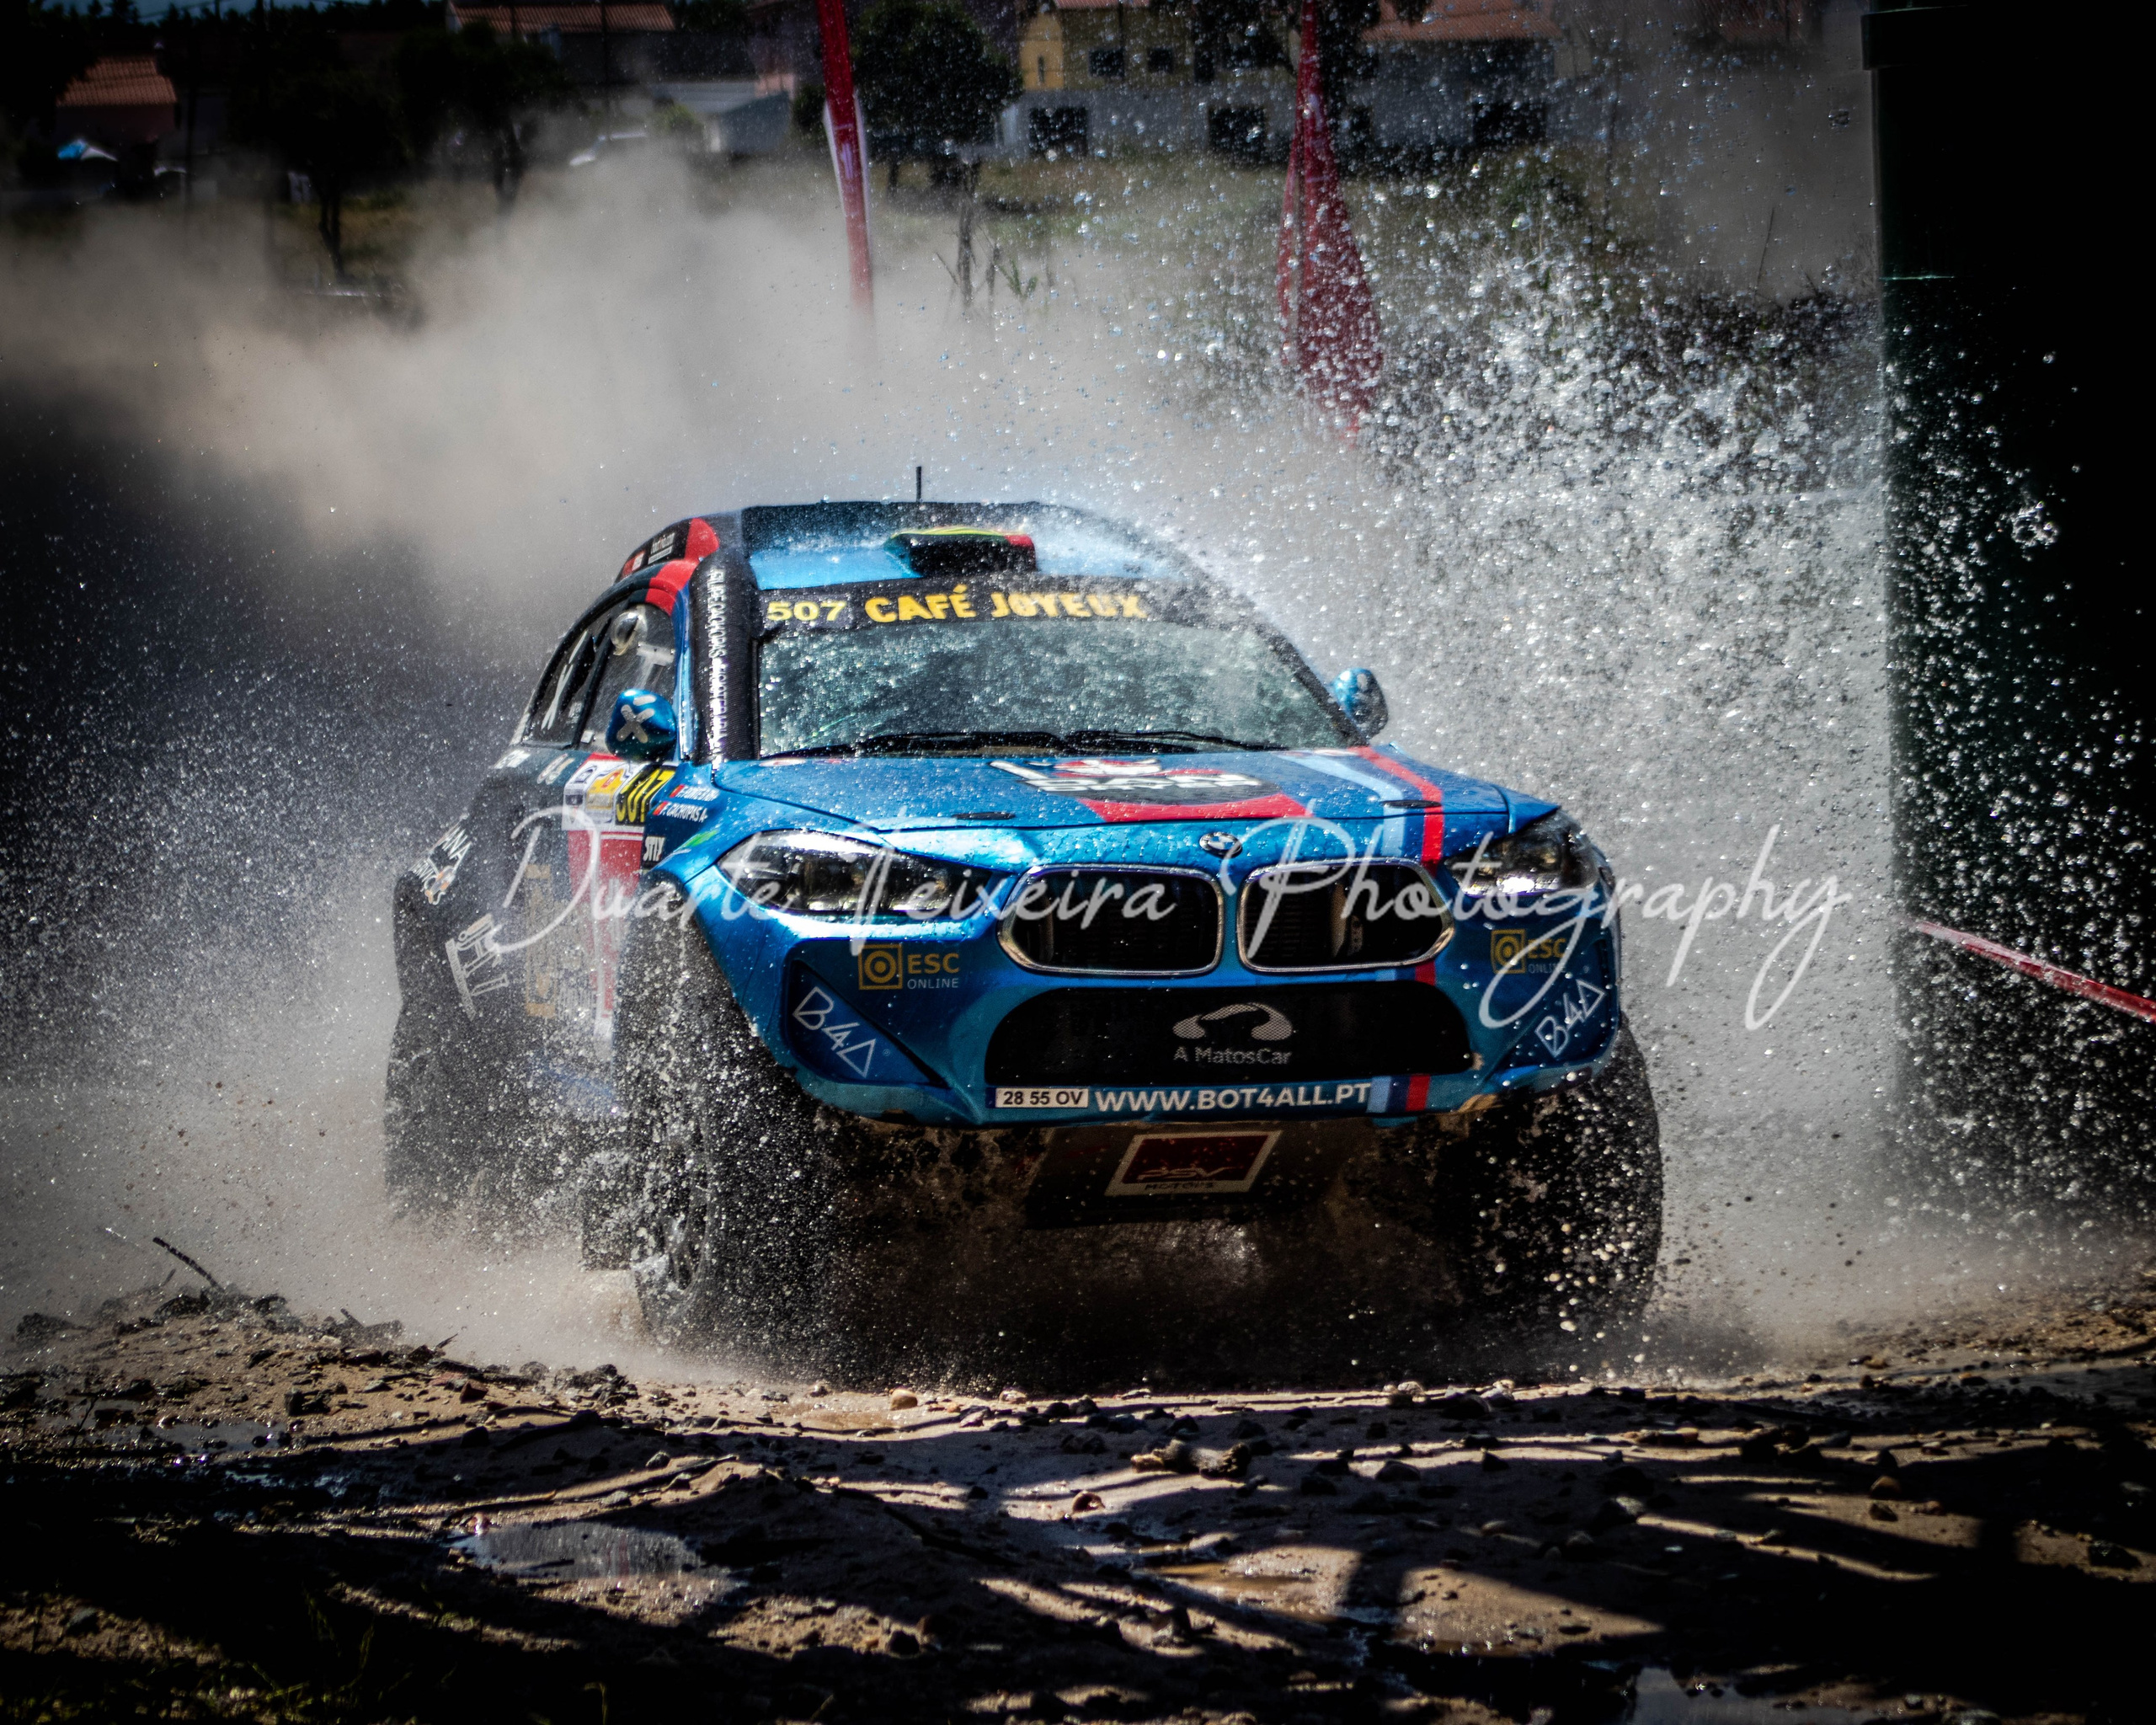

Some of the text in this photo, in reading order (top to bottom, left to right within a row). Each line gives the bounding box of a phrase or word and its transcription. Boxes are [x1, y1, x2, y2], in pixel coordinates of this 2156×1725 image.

[767, 584, 1149, 622] 507 CAFÉ JOYEUX
[666, 803, 704, 822] CACHOPAS
[907, 953, 960, 974] ESC
[907, 978, 959, 989] ONLINE
[1173, 1047, 1293, 1065] A MatosCar
[1003, 1091, 1083, 1105] 28 55 OV
[1095, 1083, 1371, 1112] WWW.BOT4ALL.PT
